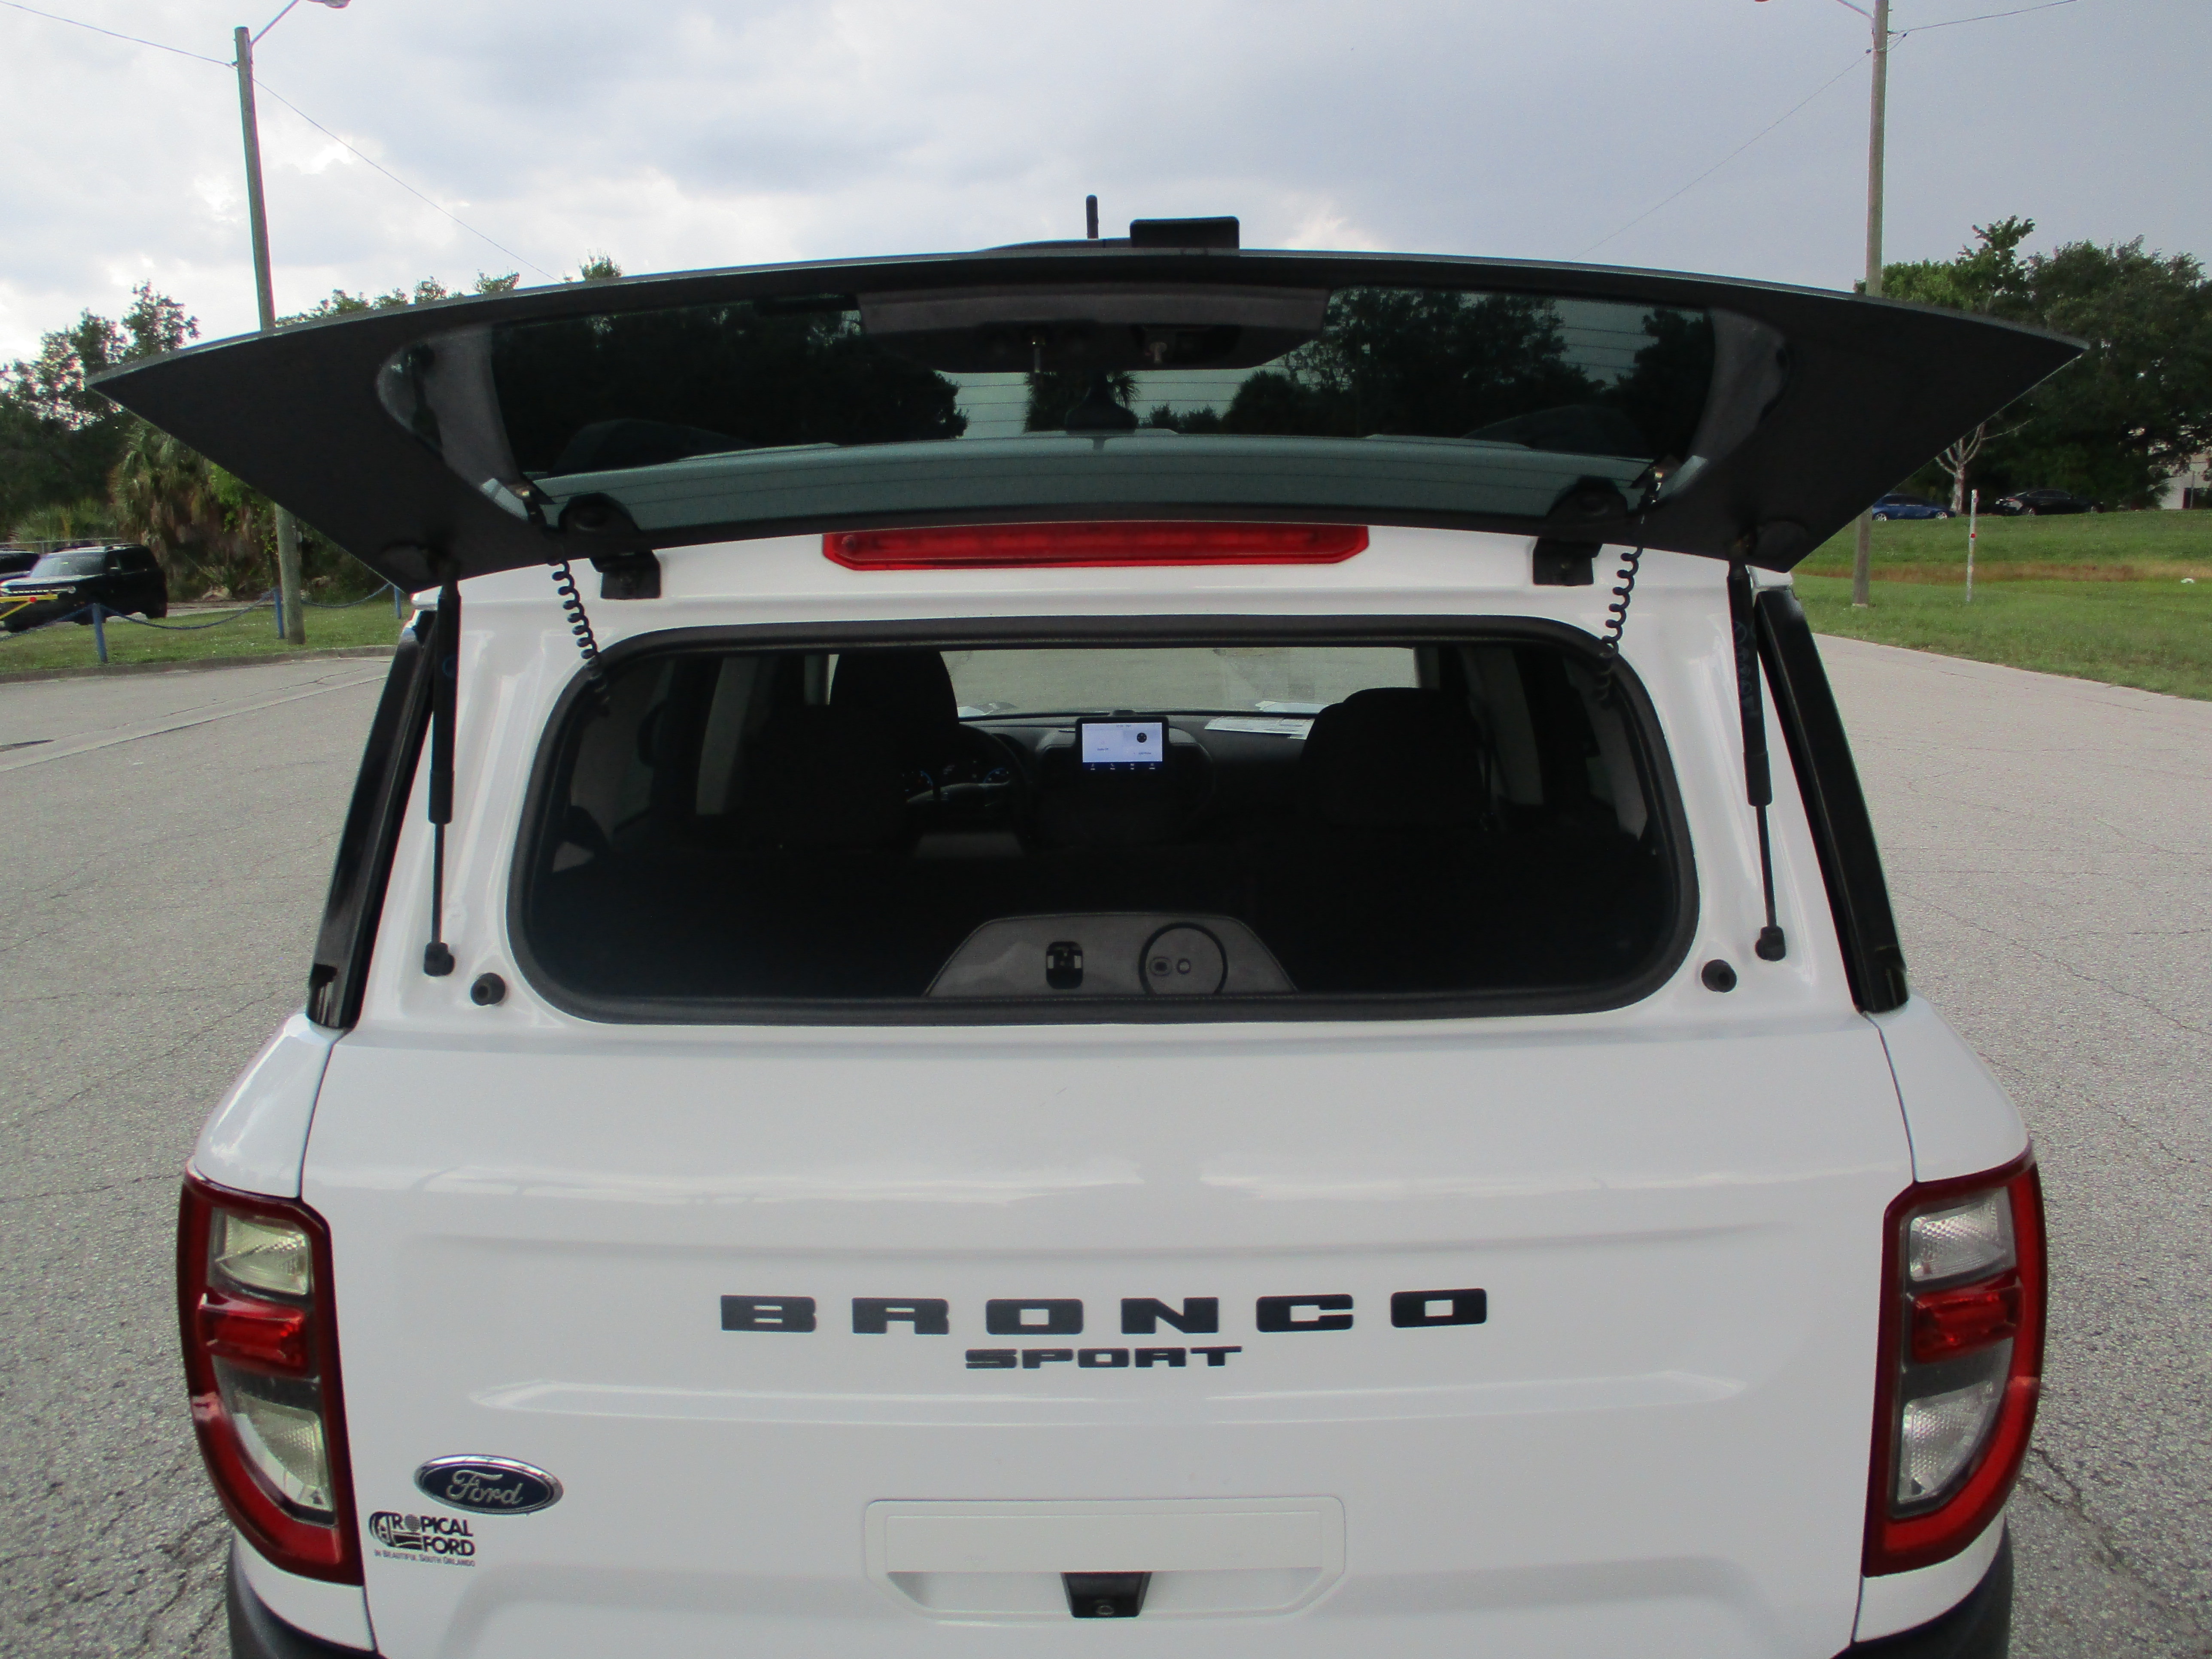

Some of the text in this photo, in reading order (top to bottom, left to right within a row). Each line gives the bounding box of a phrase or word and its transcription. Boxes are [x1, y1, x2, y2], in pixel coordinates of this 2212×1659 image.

[720, 1288, 1488, 1334] BRONCO
[966, 1346, 1243, 1369] SPORT
[446, 1469, 524, 1505] Ford
[370, 1511, 474, 1537] TROPICAL
[422, 1535, 475, 1556] FORD
